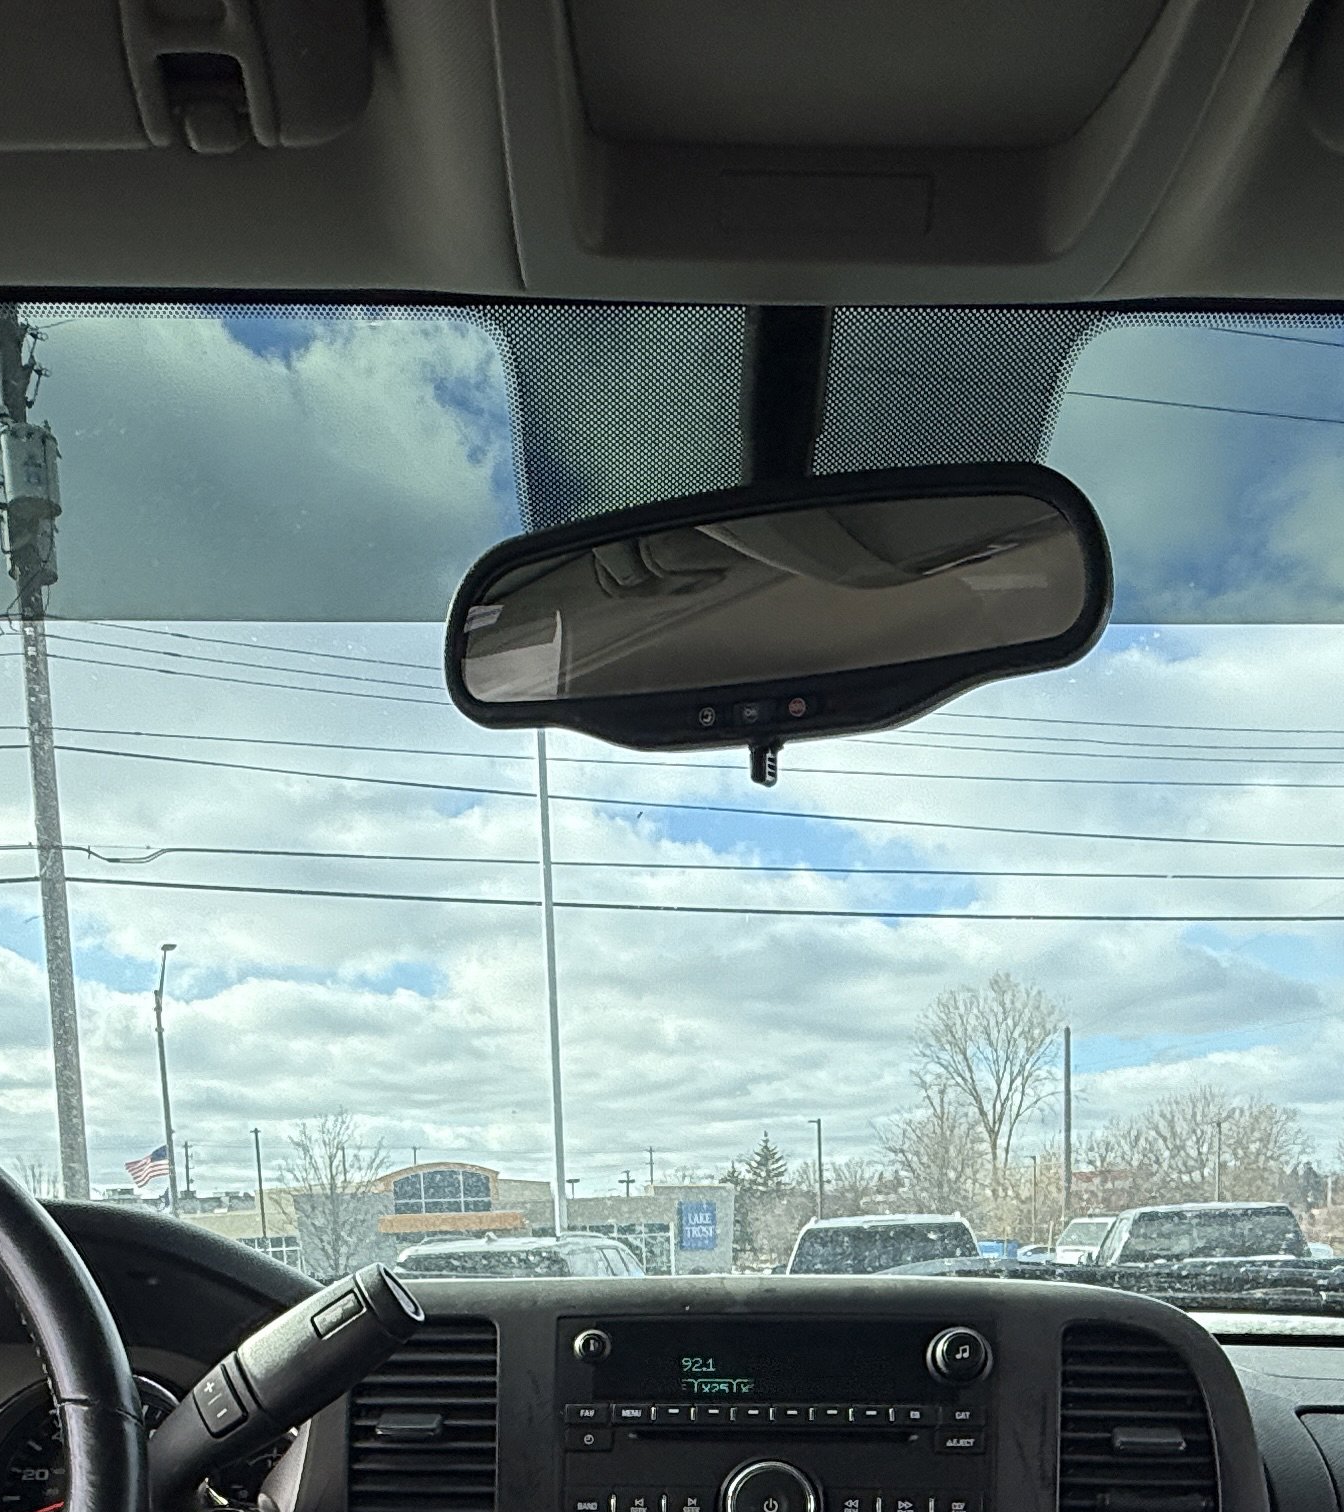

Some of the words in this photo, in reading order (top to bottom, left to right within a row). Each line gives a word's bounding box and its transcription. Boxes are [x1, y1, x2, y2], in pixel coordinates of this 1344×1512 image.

[688, 1213, 712, 1224] LAKE
[685, 1225, 714, 1238] TRUST
[681, 1357, 716, 1372] 92.1
[21, 1468, 49, 1481] 20
